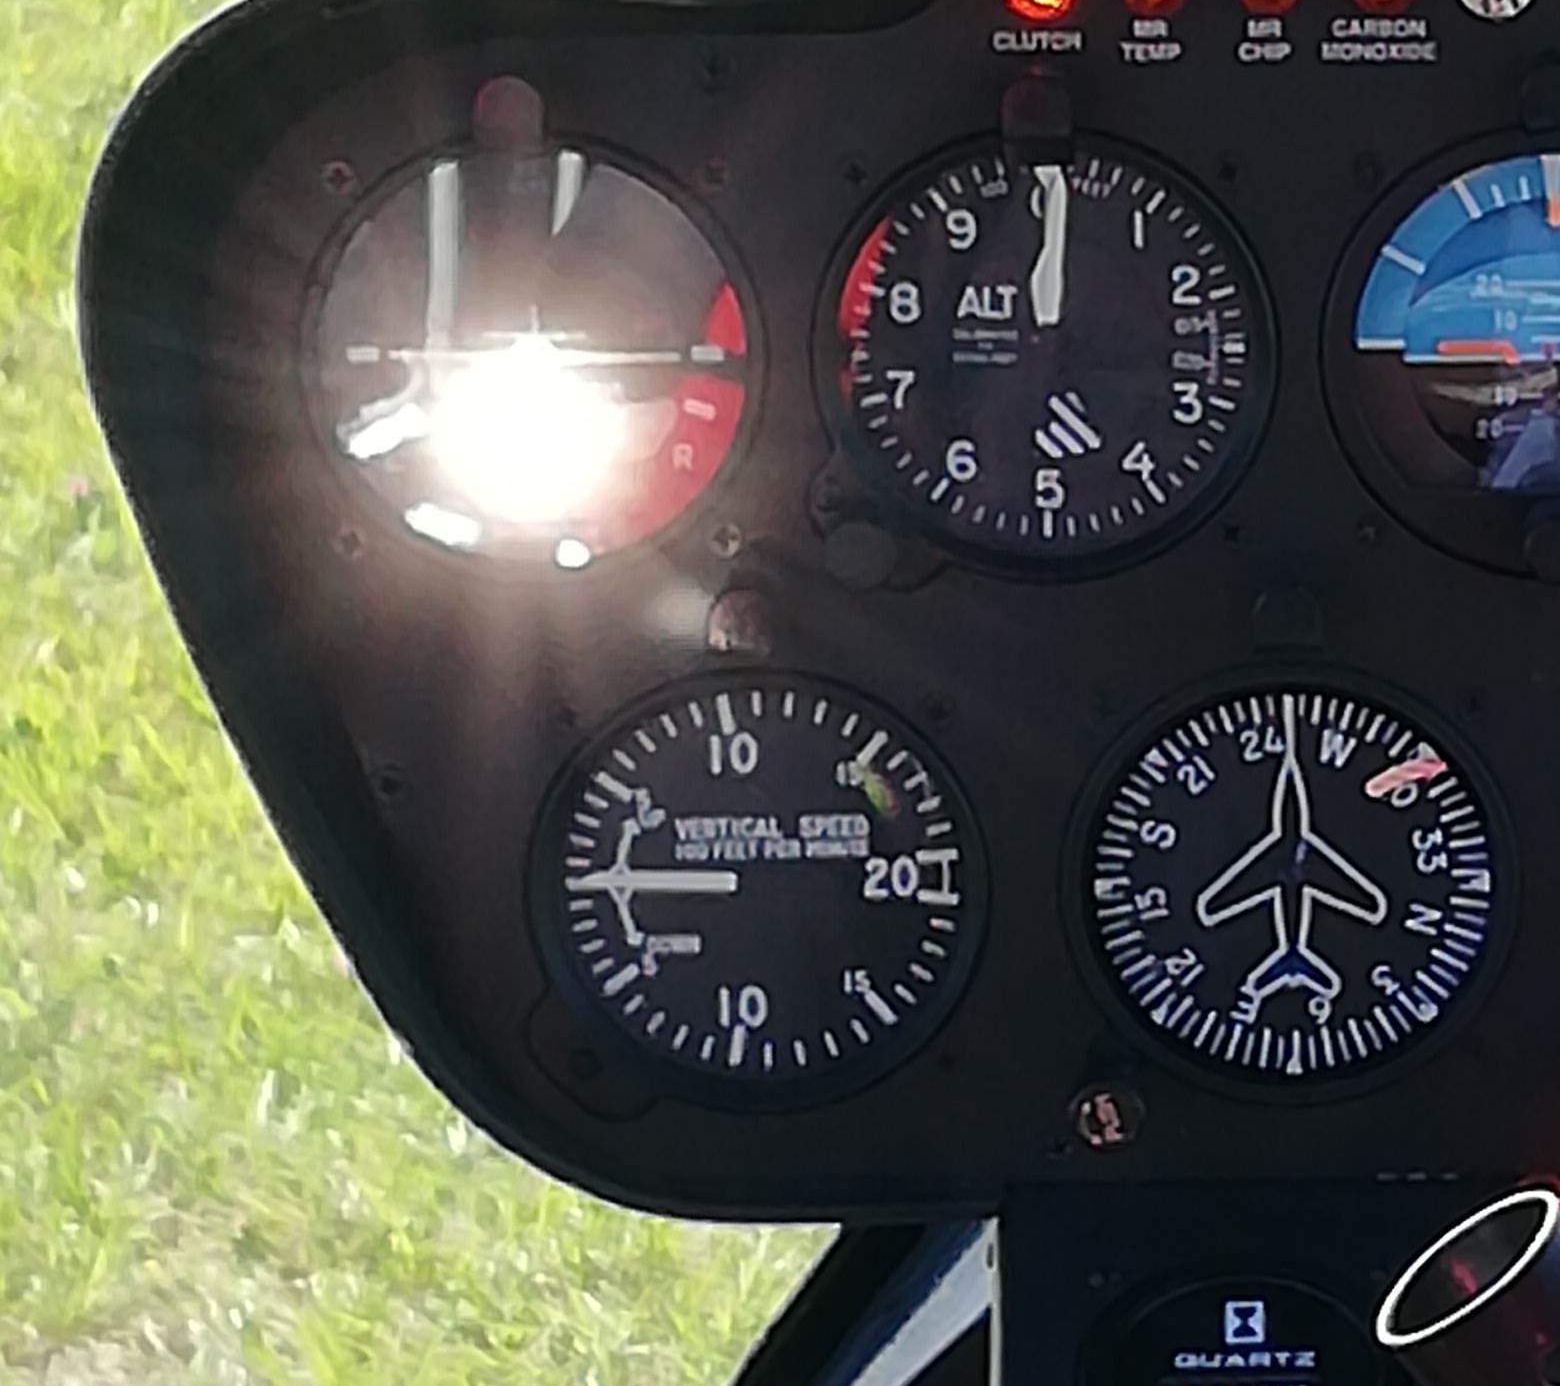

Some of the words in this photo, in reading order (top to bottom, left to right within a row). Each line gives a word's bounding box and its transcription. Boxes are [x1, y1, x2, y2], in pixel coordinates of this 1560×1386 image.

[993, 32, 1082, 52] CLUTCH
[1332, 20, 1427, 40] CARBON
[1120, 42, 1183, 63] TEMP
[1237, 42, 1292, 64] CHIP
[1320, 42, 1438, 63] MONOXIDE
[946, 209, 978, 250] 9
[1133, 210, 1144, 249] 1
[888, 282, 922, 324] 8
[957, 285, 1018, 320] ALT
[1171, 264, 1201, 306] 2
[886, 369, 916, 409] 7
[1172, 382, 1202, 424] 3
[672, 445, 694, 471] R
[946, 439, 978, 482] 6
[1121, 440, 1155, 480] 4
[1035, 468, 1065, 510] 5
[709, 732, 759, 774] 10
[1239, 726, 1285, 762] 24
[1319, 728, 1357, 768] W
[1176, 754, 1216, 795] 21
[674, 817, 784, 839] VERTICAL
[799, 813, 870, 838] SPEED
[1139, 819, 1177, 849] S
[1411, 828, 1447, 874] 33
[863, 855, 918, 898] 20
[1135, 887, 1169, 921] 15
[1404, 903, 1443, 936] N
[1165, 948, 1205, 987] 12
[718, 984, 769, 1029] 10
